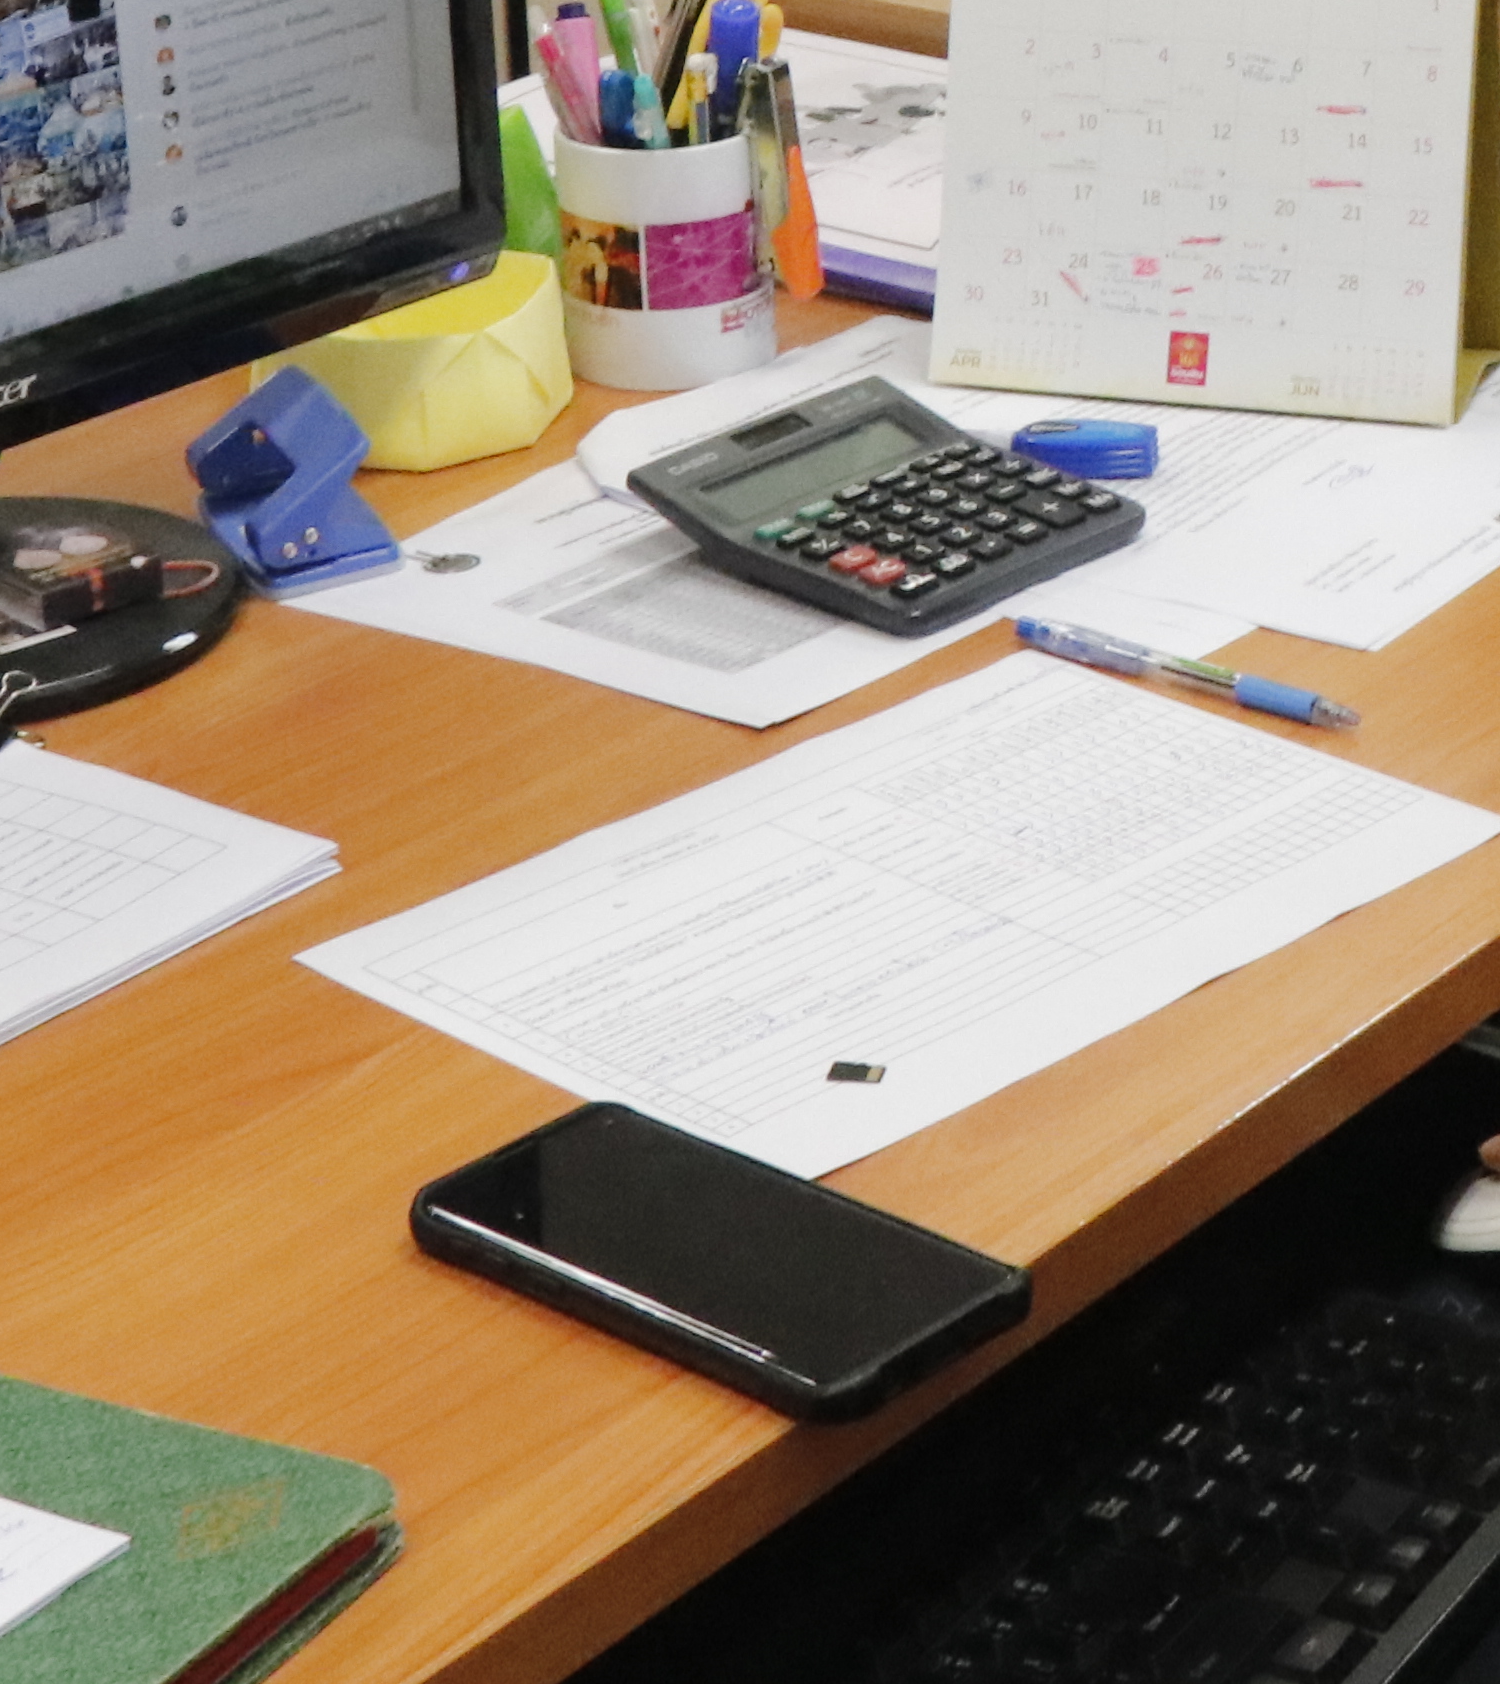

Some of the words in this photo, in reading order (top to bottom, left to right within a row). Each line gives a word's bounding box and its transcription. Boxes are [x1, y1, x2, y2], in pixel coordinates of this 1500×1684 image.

[1025, 39, 1036, 56] 2
[1092, 44, 1102, 59] 3
[1158, 47, 1169, 64] 4
[1226, 52, 1236, 69] 5
[1293, 58, 1304, 74] 6
[1363, 61, 1373, 77] 7
[1426, 65, 1438, 83] 8
[1021, 109, 1032, 126] 9
[1078, 113, 1098, 131] 10
[1145, 118, 1165, 135] 11
[1211, 123, 1232, 140] 12
[1280, 128, 1300, 145] 13
[1347, 132, 1368, 150] 14
[1413, 137, 1434, 155] 15
[1007, 180, 1028, 198] 16
[1073, 184, 1094, 202] 17
[1140, 189, 1162, 206] 18
[1207, 194, 1229, 212] 19
[1274, 199, 1296, 217] 20
[1342, 204, 1363, 222] 21
[1407, 209, 1430, 227] 22
[1002, 248, 1023, 265] 23
[1067, 252, 1089, 271] 24
[1134, 257, 1158, 275] 25
[1202, 263, 1224, 281] 26
[1270, 268, 1293, 286] 27
[1338, 273, 1360, 292] 28
[1404, 279, 1426, 297] 29
[964, 285, 985, 303] 30
[1031, 290, 1051, 308] 31
[950, 353, 982, 369] APR
[1290, 382, 1320, 397] JUN
